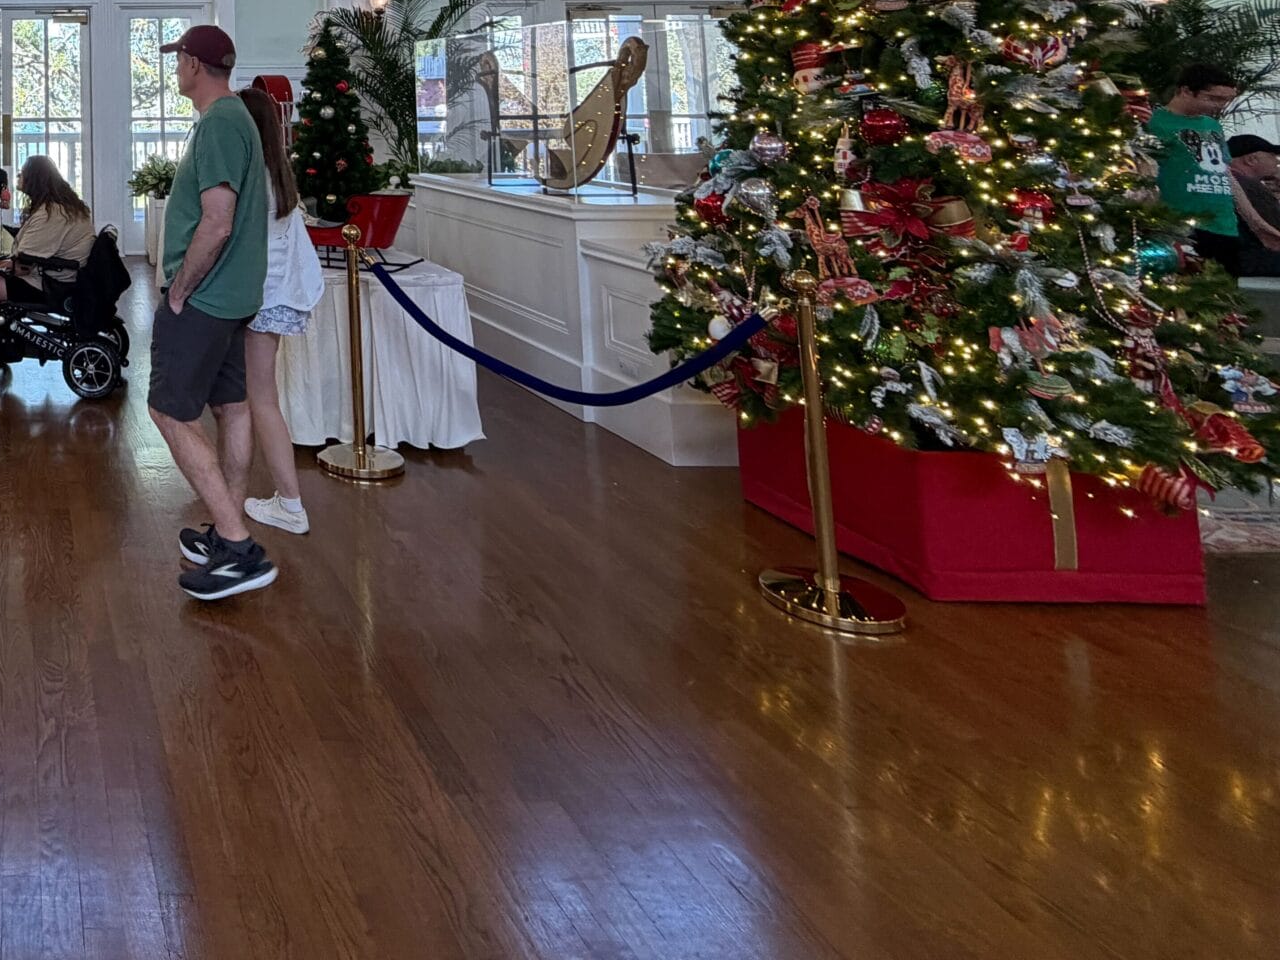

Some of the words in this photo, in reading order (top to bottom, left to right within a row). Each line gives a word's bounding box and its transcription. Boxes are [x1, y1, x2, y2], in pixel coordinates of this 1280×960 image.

[1194, 174, 1229, 185] MOS
[1186, 183, 1232, 195] MERR
[16, 326, 65, 357] MAJESTIC
